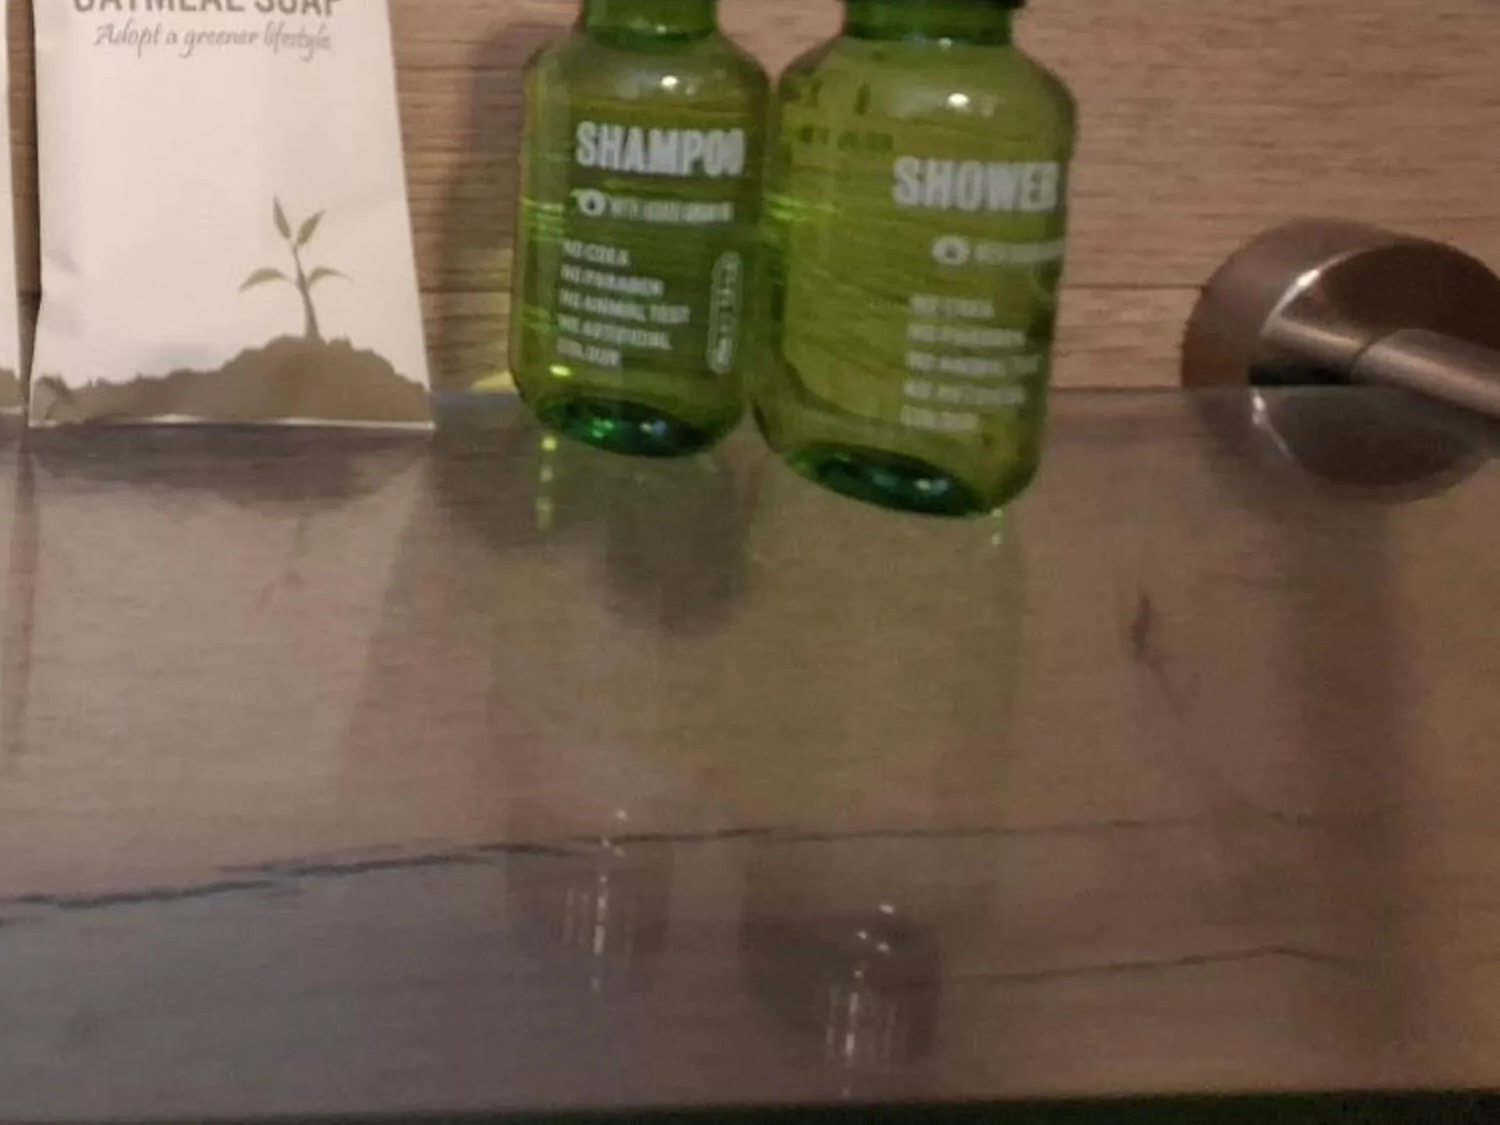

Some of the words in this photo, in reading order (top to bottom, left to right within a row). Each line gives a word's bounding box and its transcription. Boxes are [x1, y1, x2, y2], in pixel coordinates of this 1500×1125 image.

[94, 18, 160, 59] Adopt
[164, 29, 179, 46] a
[182, 27, 260, 59] greener
[263, 19, 332, 63] lifestyle
[576, 120, 745, 177] SHAMPOO
